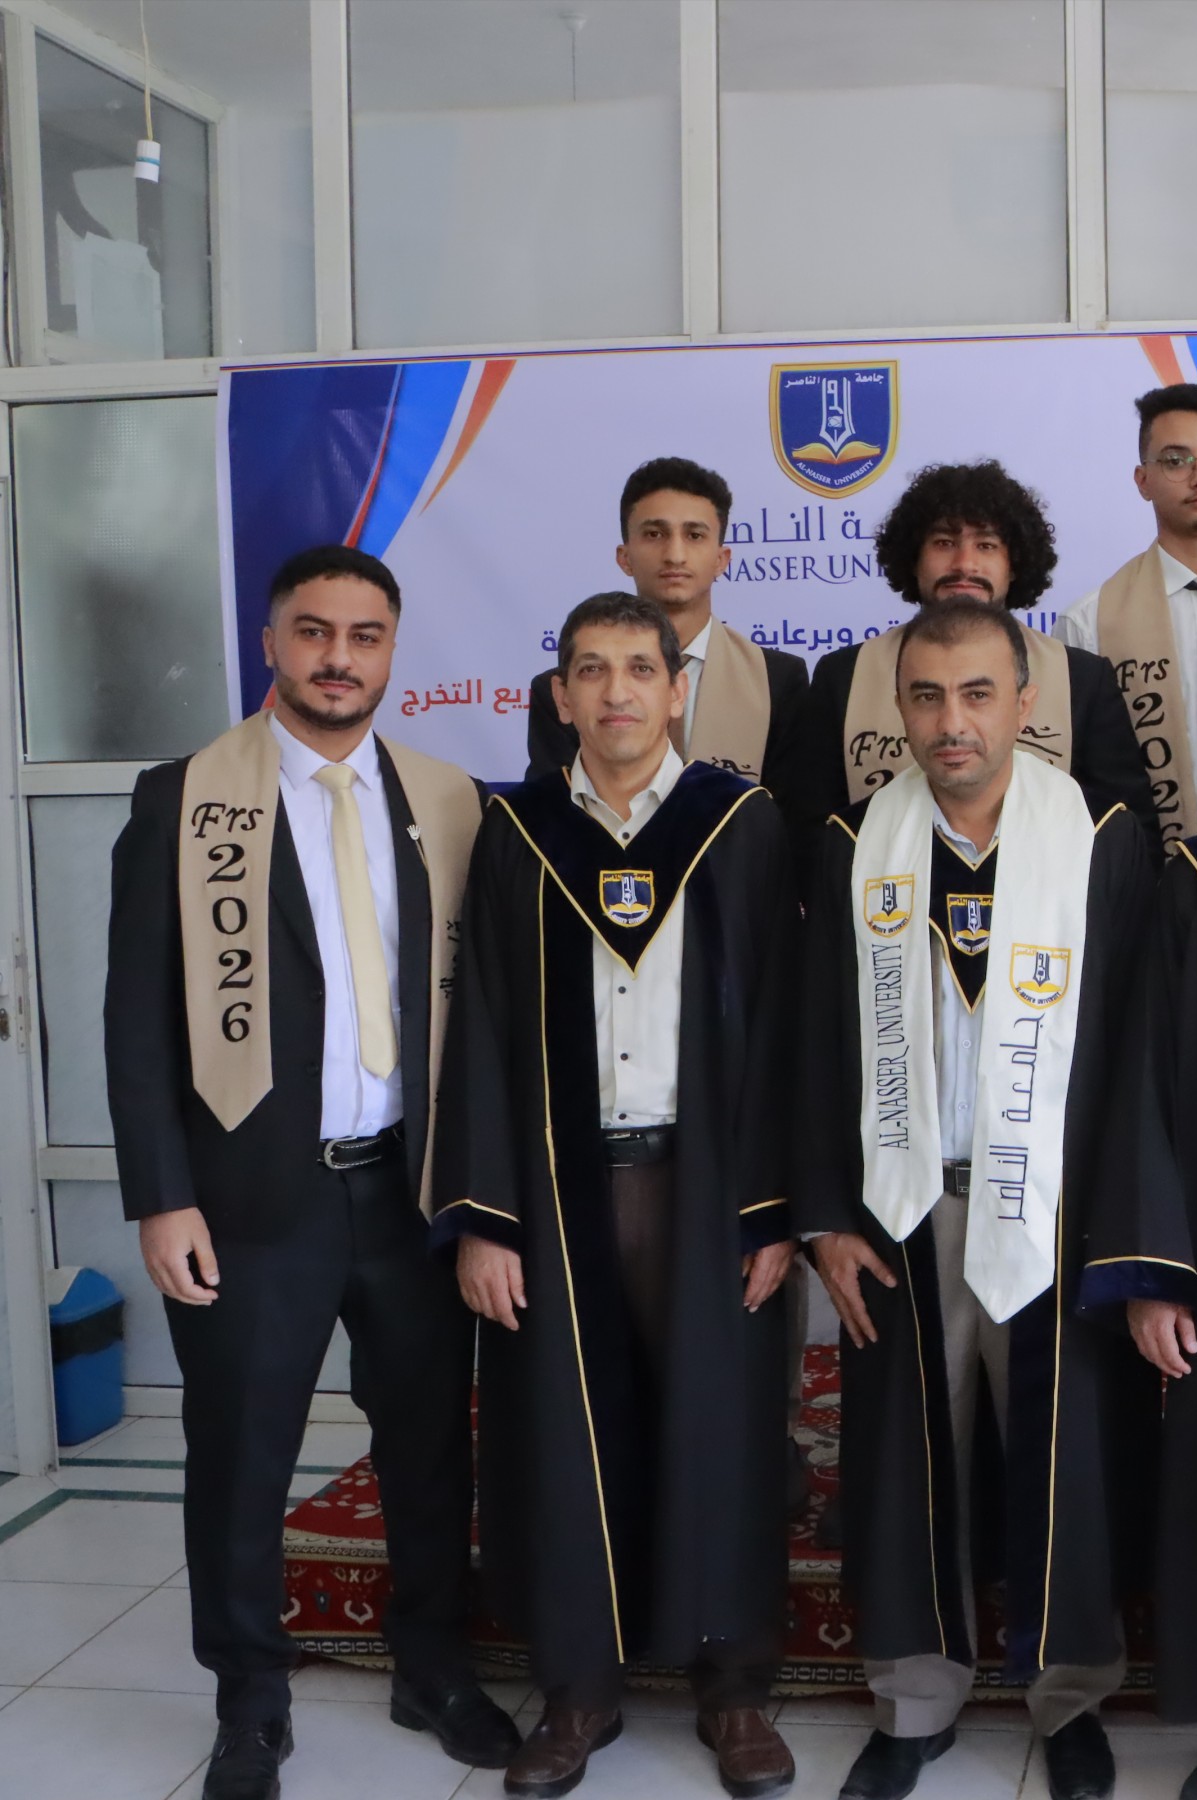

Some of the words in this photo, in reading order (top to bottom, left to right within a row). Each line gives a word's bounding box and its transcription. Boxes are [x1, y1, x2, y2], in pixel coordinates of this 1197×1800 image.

[785, 375, 821, 388] الناصر
[855, 372, 884, 384] جامعة
[796, 461, 831, 485] AL-NASSER
[834, 460, 874, 486] UNIVERSITY
[400, 678, 482, 717] التخرج
[850, 731, 909, 767] Frs
[191, 802, 264, 839] Frs
[206, 843, 254, 1043] 2026
[871, 943, 905, 1047] UNIVERSITY
[999, 1012, 1046, 1123] جامعة
[875, 1045, 909, 1150] AL-NASSER
[987, 1145, 1029, 1225] الناصر
